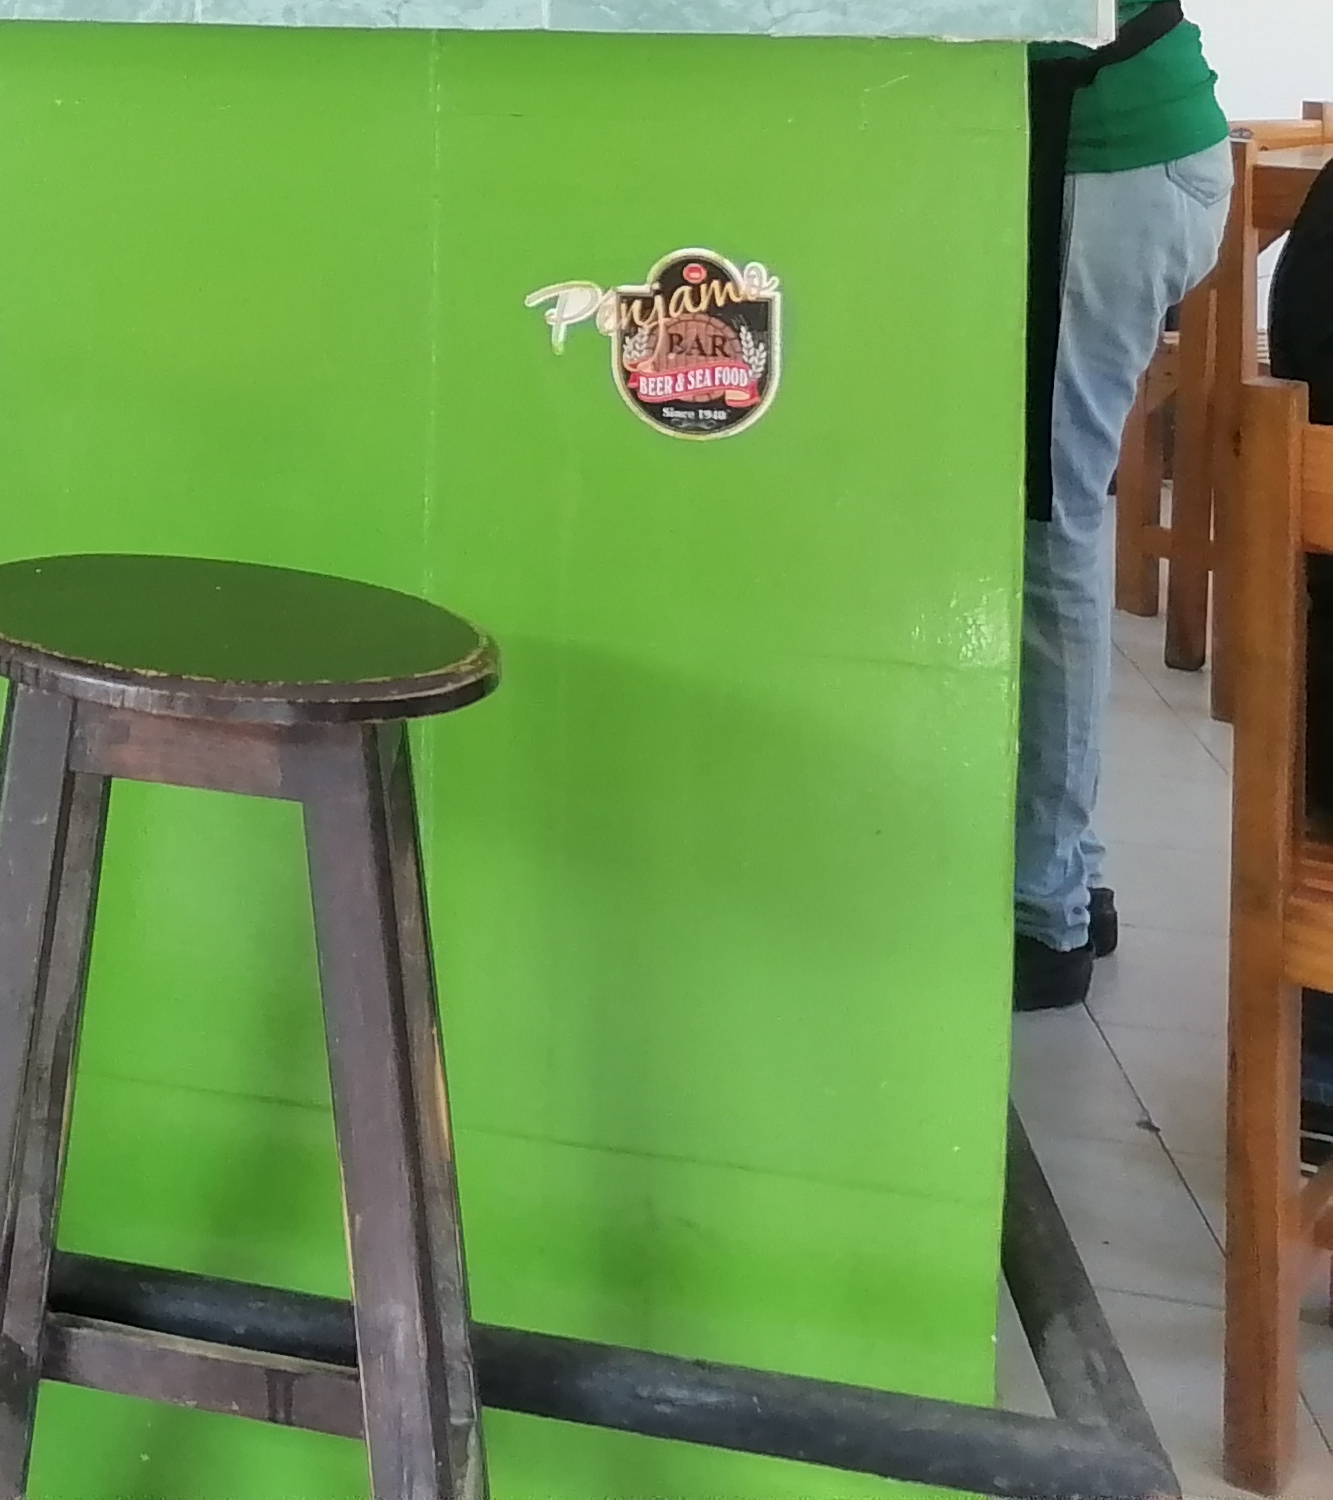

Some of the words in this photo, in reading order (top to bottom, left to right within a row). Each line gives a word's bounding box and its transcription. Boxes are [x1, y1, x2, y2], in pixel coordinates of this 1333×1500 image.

[669, 332, 731, 358] BAR
[639, 376, 673, 398] BEER
[675, 374, 684, 393] &
[687, 369, 712, 390] SEA
[714, 366, 749, 388] FOOD
[662, 406, 696, 420] Since
